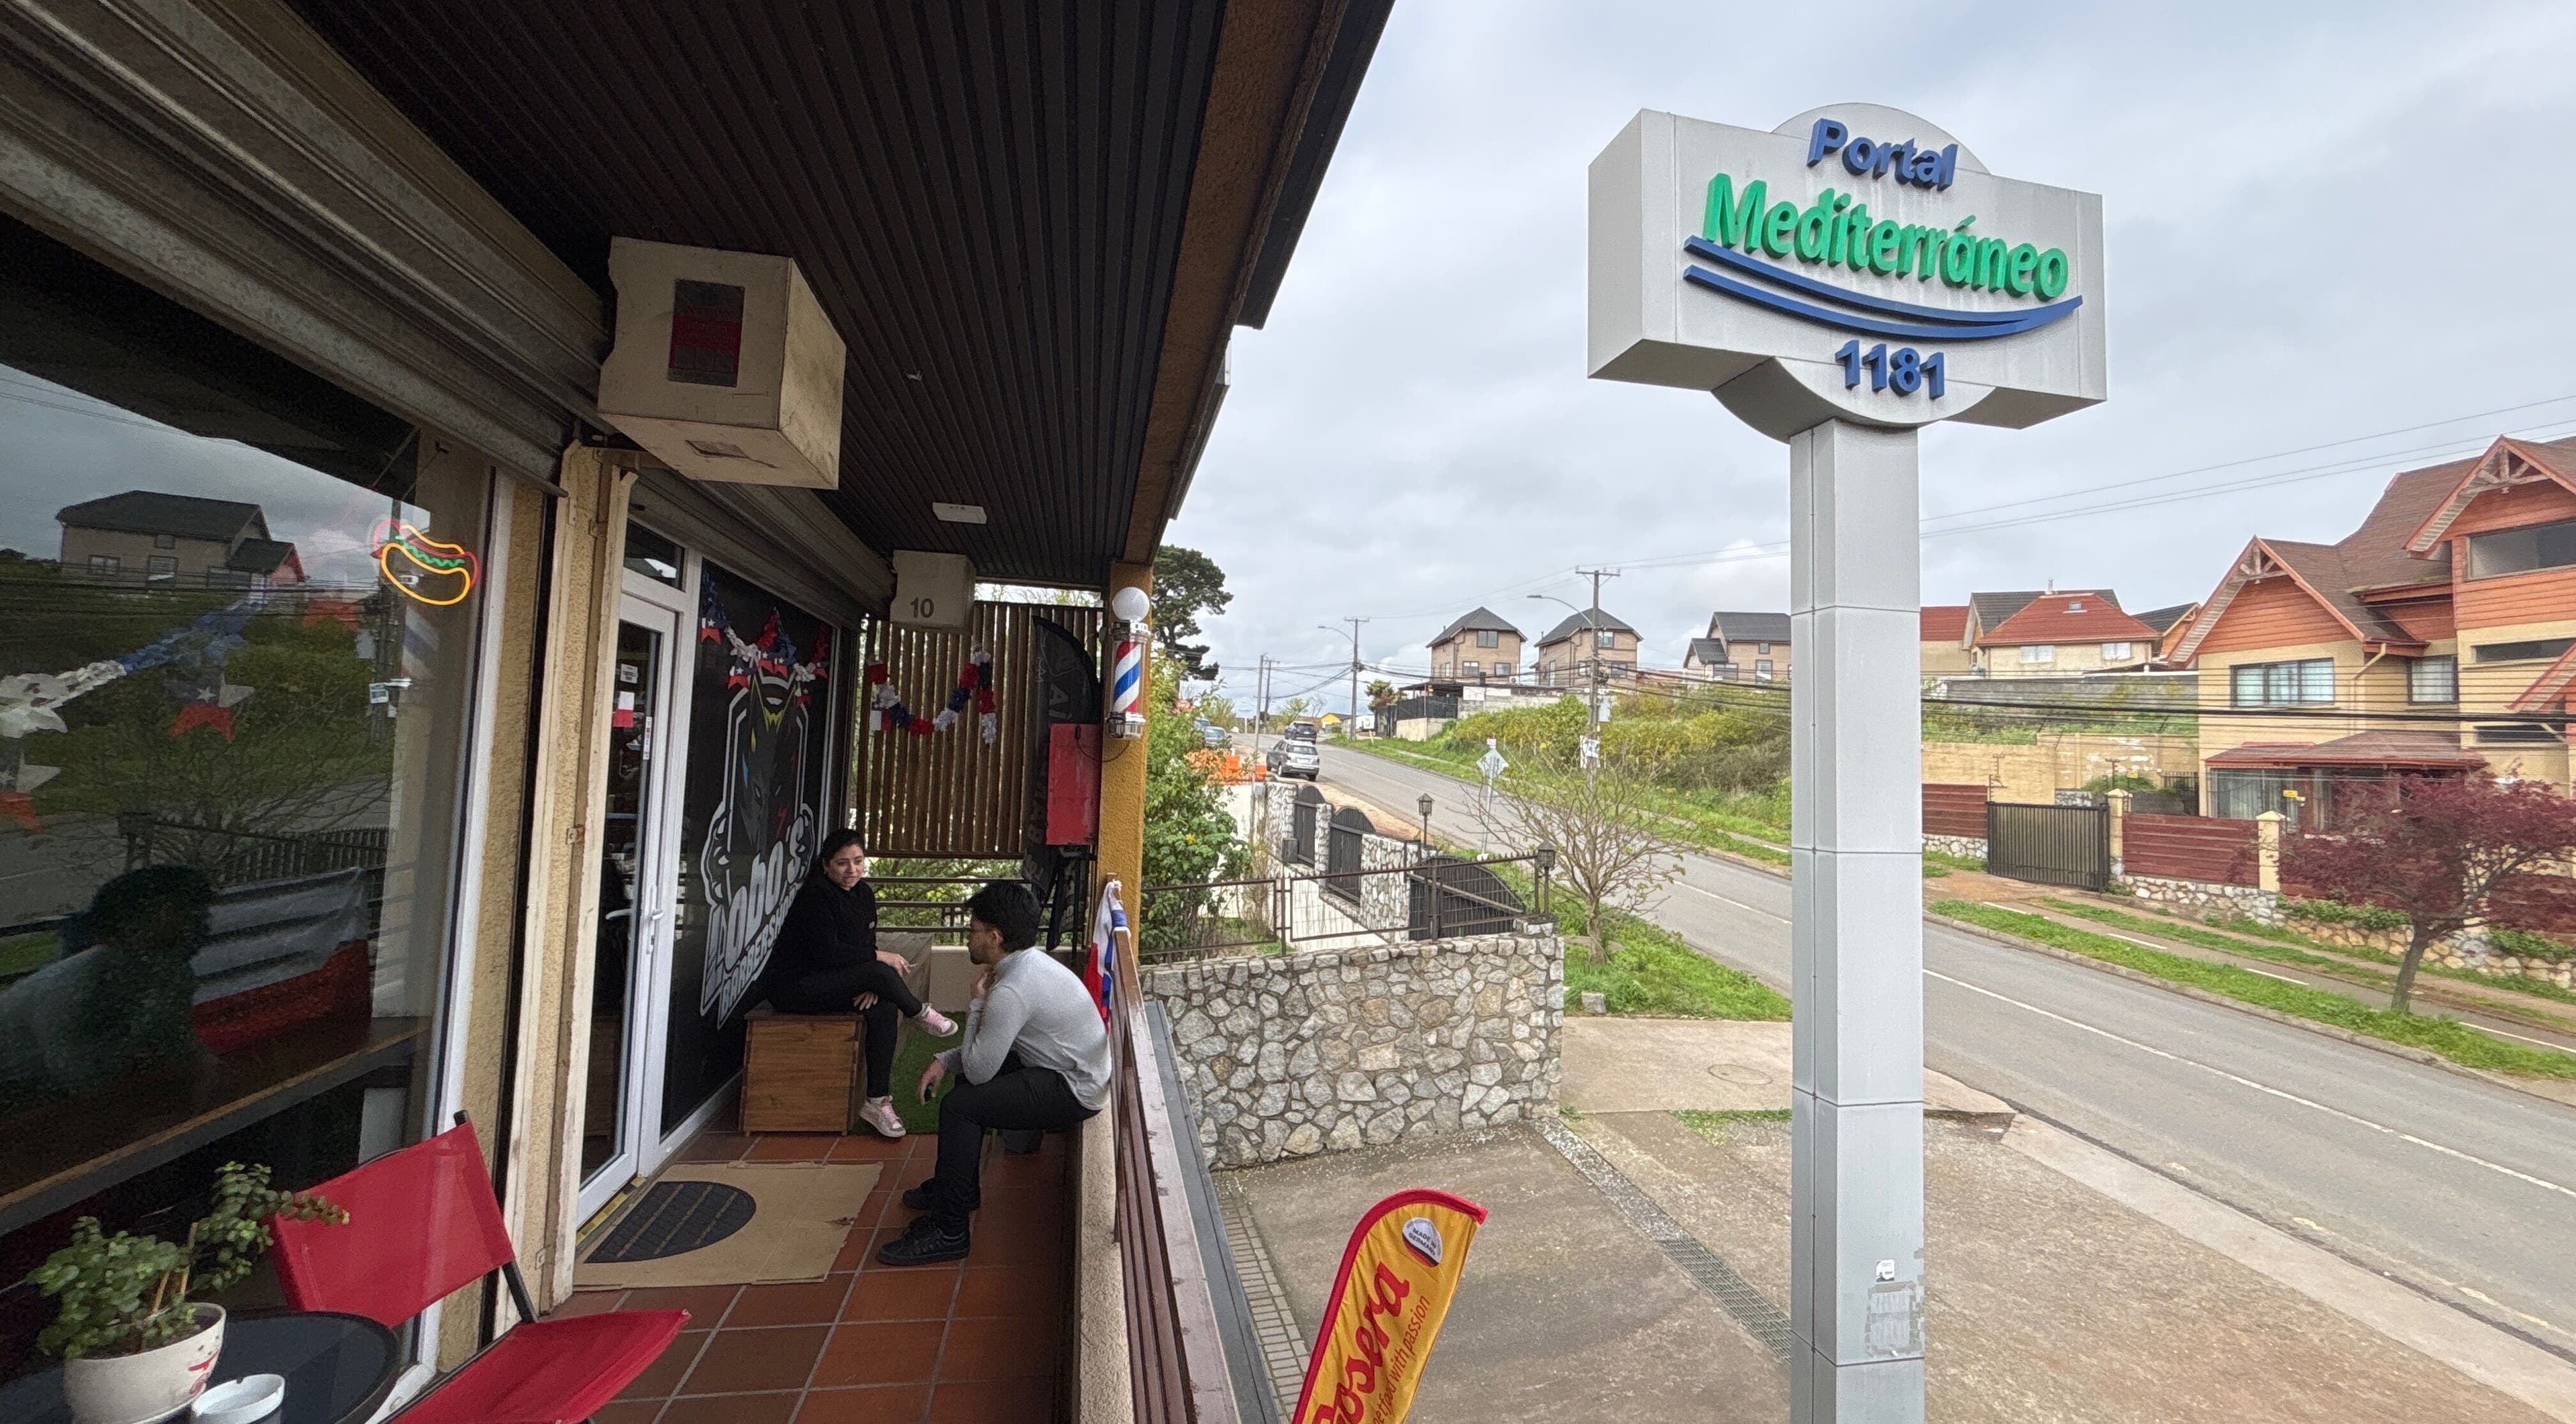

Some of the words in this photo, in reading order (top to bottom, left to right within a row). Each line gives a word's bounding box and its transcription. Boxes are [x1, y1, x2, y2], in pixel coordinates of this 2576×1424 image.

[1807, 119, 1958, 191] Portal
[1703, 173, 2068, 300] Mediterráneo
[1835, 339, 1945, 399] 1181
[910, 597, 934, 618] 10
[1413, 1227, 1431, 1242] MADE
[1389, 1348, 1409, 1382] with
[1403, 1295, 1430, 1356] passion
